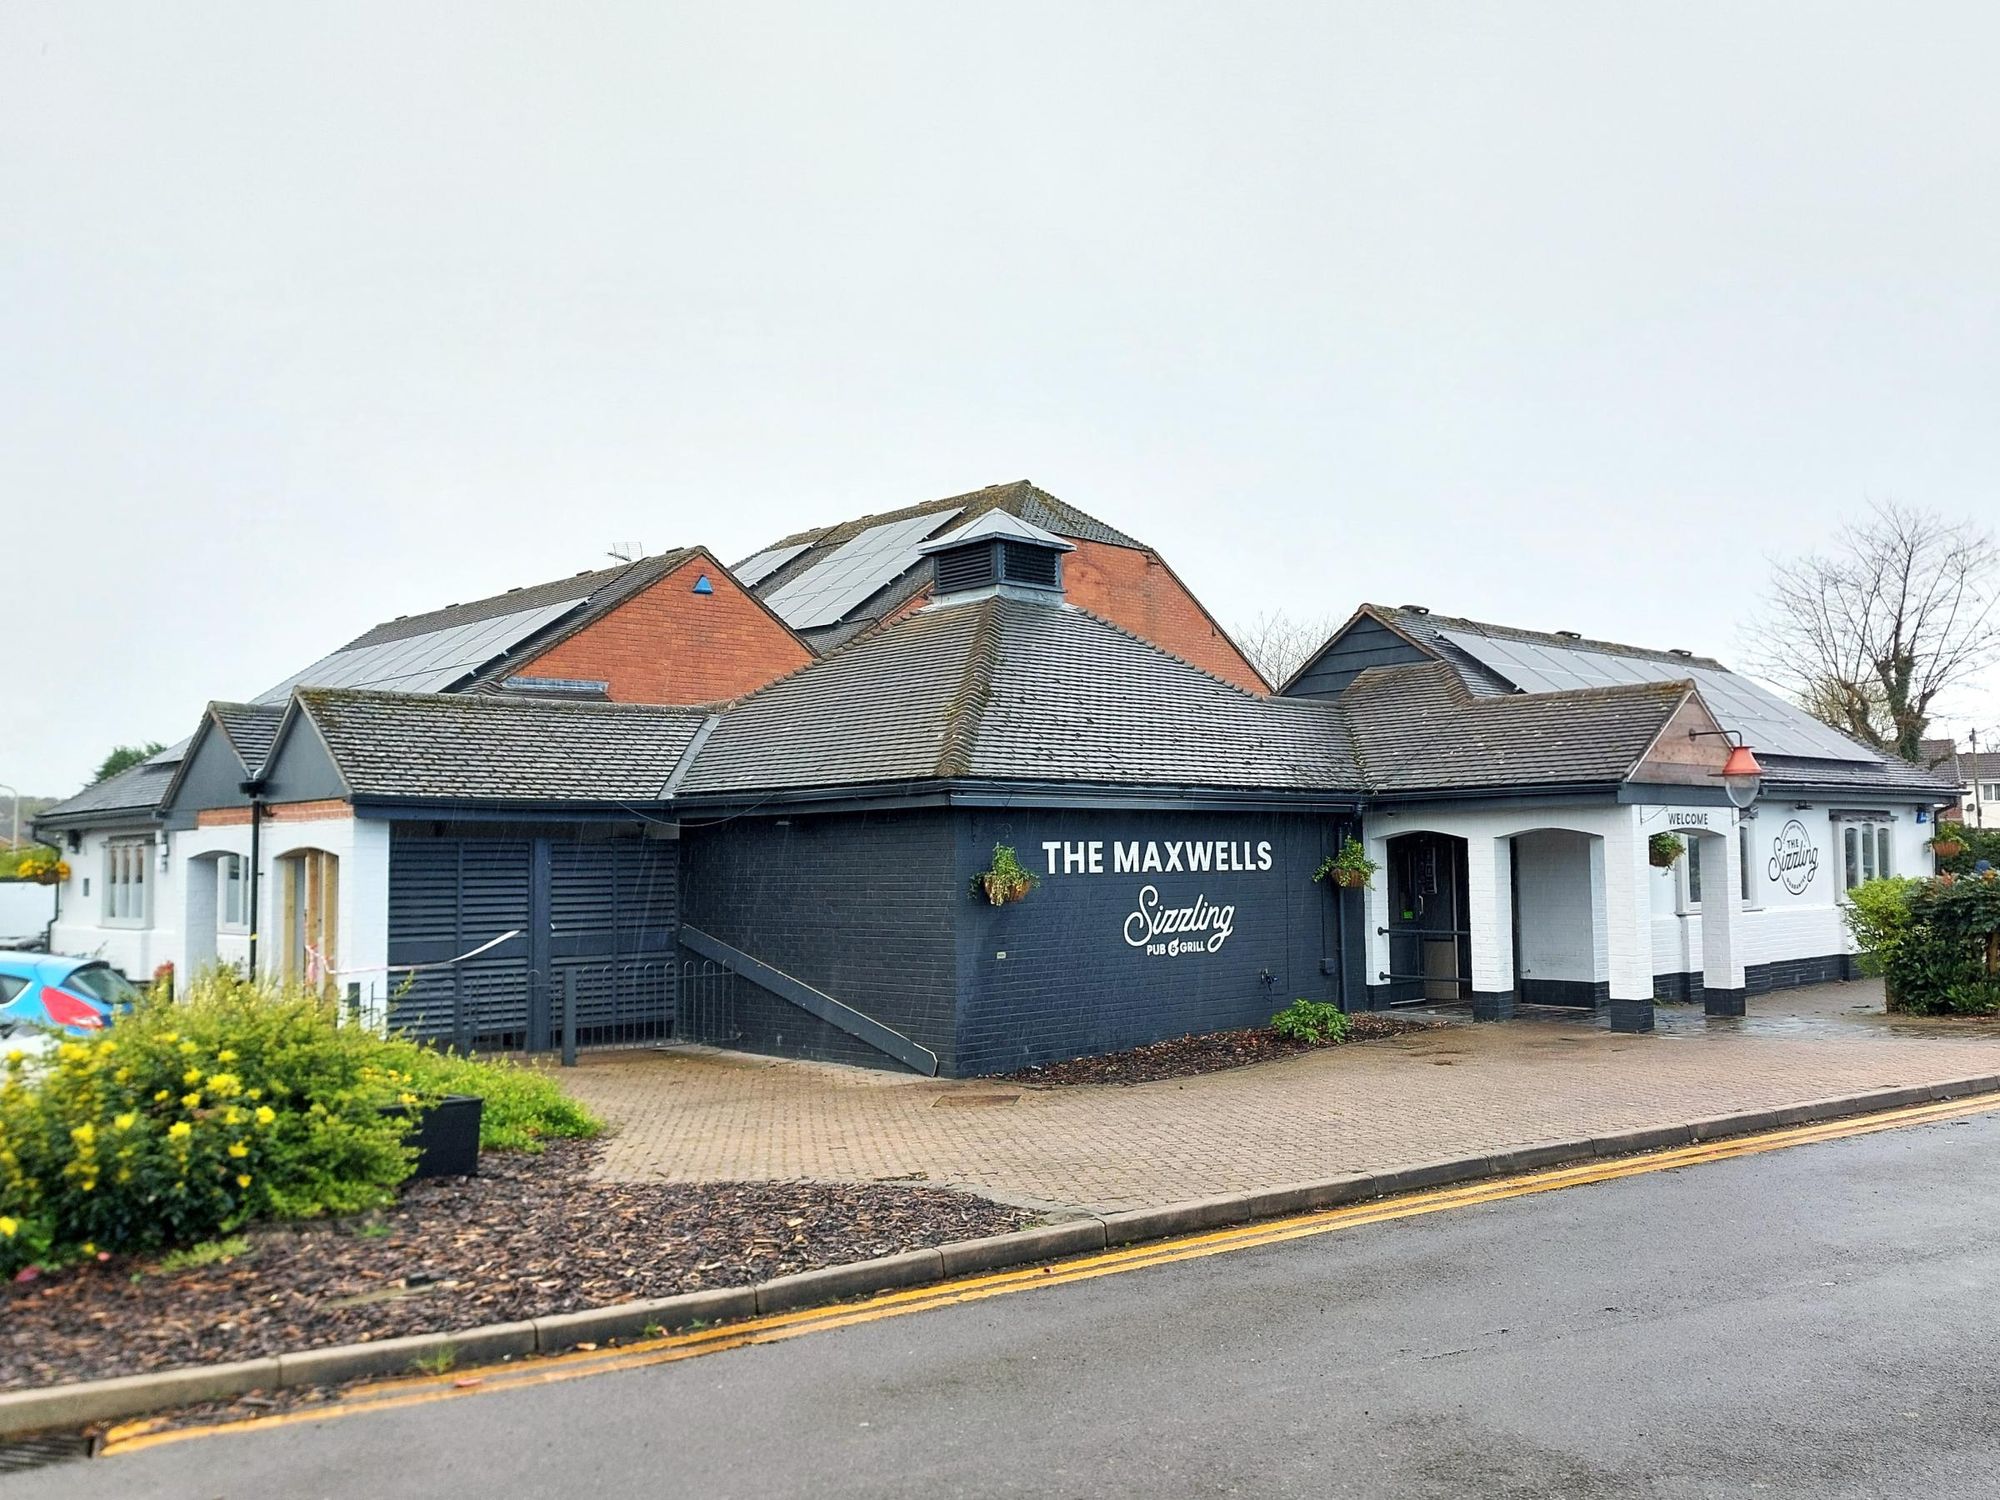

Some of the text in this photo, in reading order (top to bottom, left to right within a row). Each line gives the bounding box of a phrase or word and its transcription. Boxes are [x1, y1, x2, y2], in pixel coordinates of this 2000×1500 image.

[1668, 813, 1709, 825] WELCOME
[1787, 838, 1800, 849] THE
[1042, 841, 1273, 874] THE MAXWELLS
[1768, 836, 1819, 883] Sizzling
[1123, 885, 1235, 953] Sizzling
[1146, 943, 1167, 956] PUB
[1179, 940, 1206, 953] GRILL
